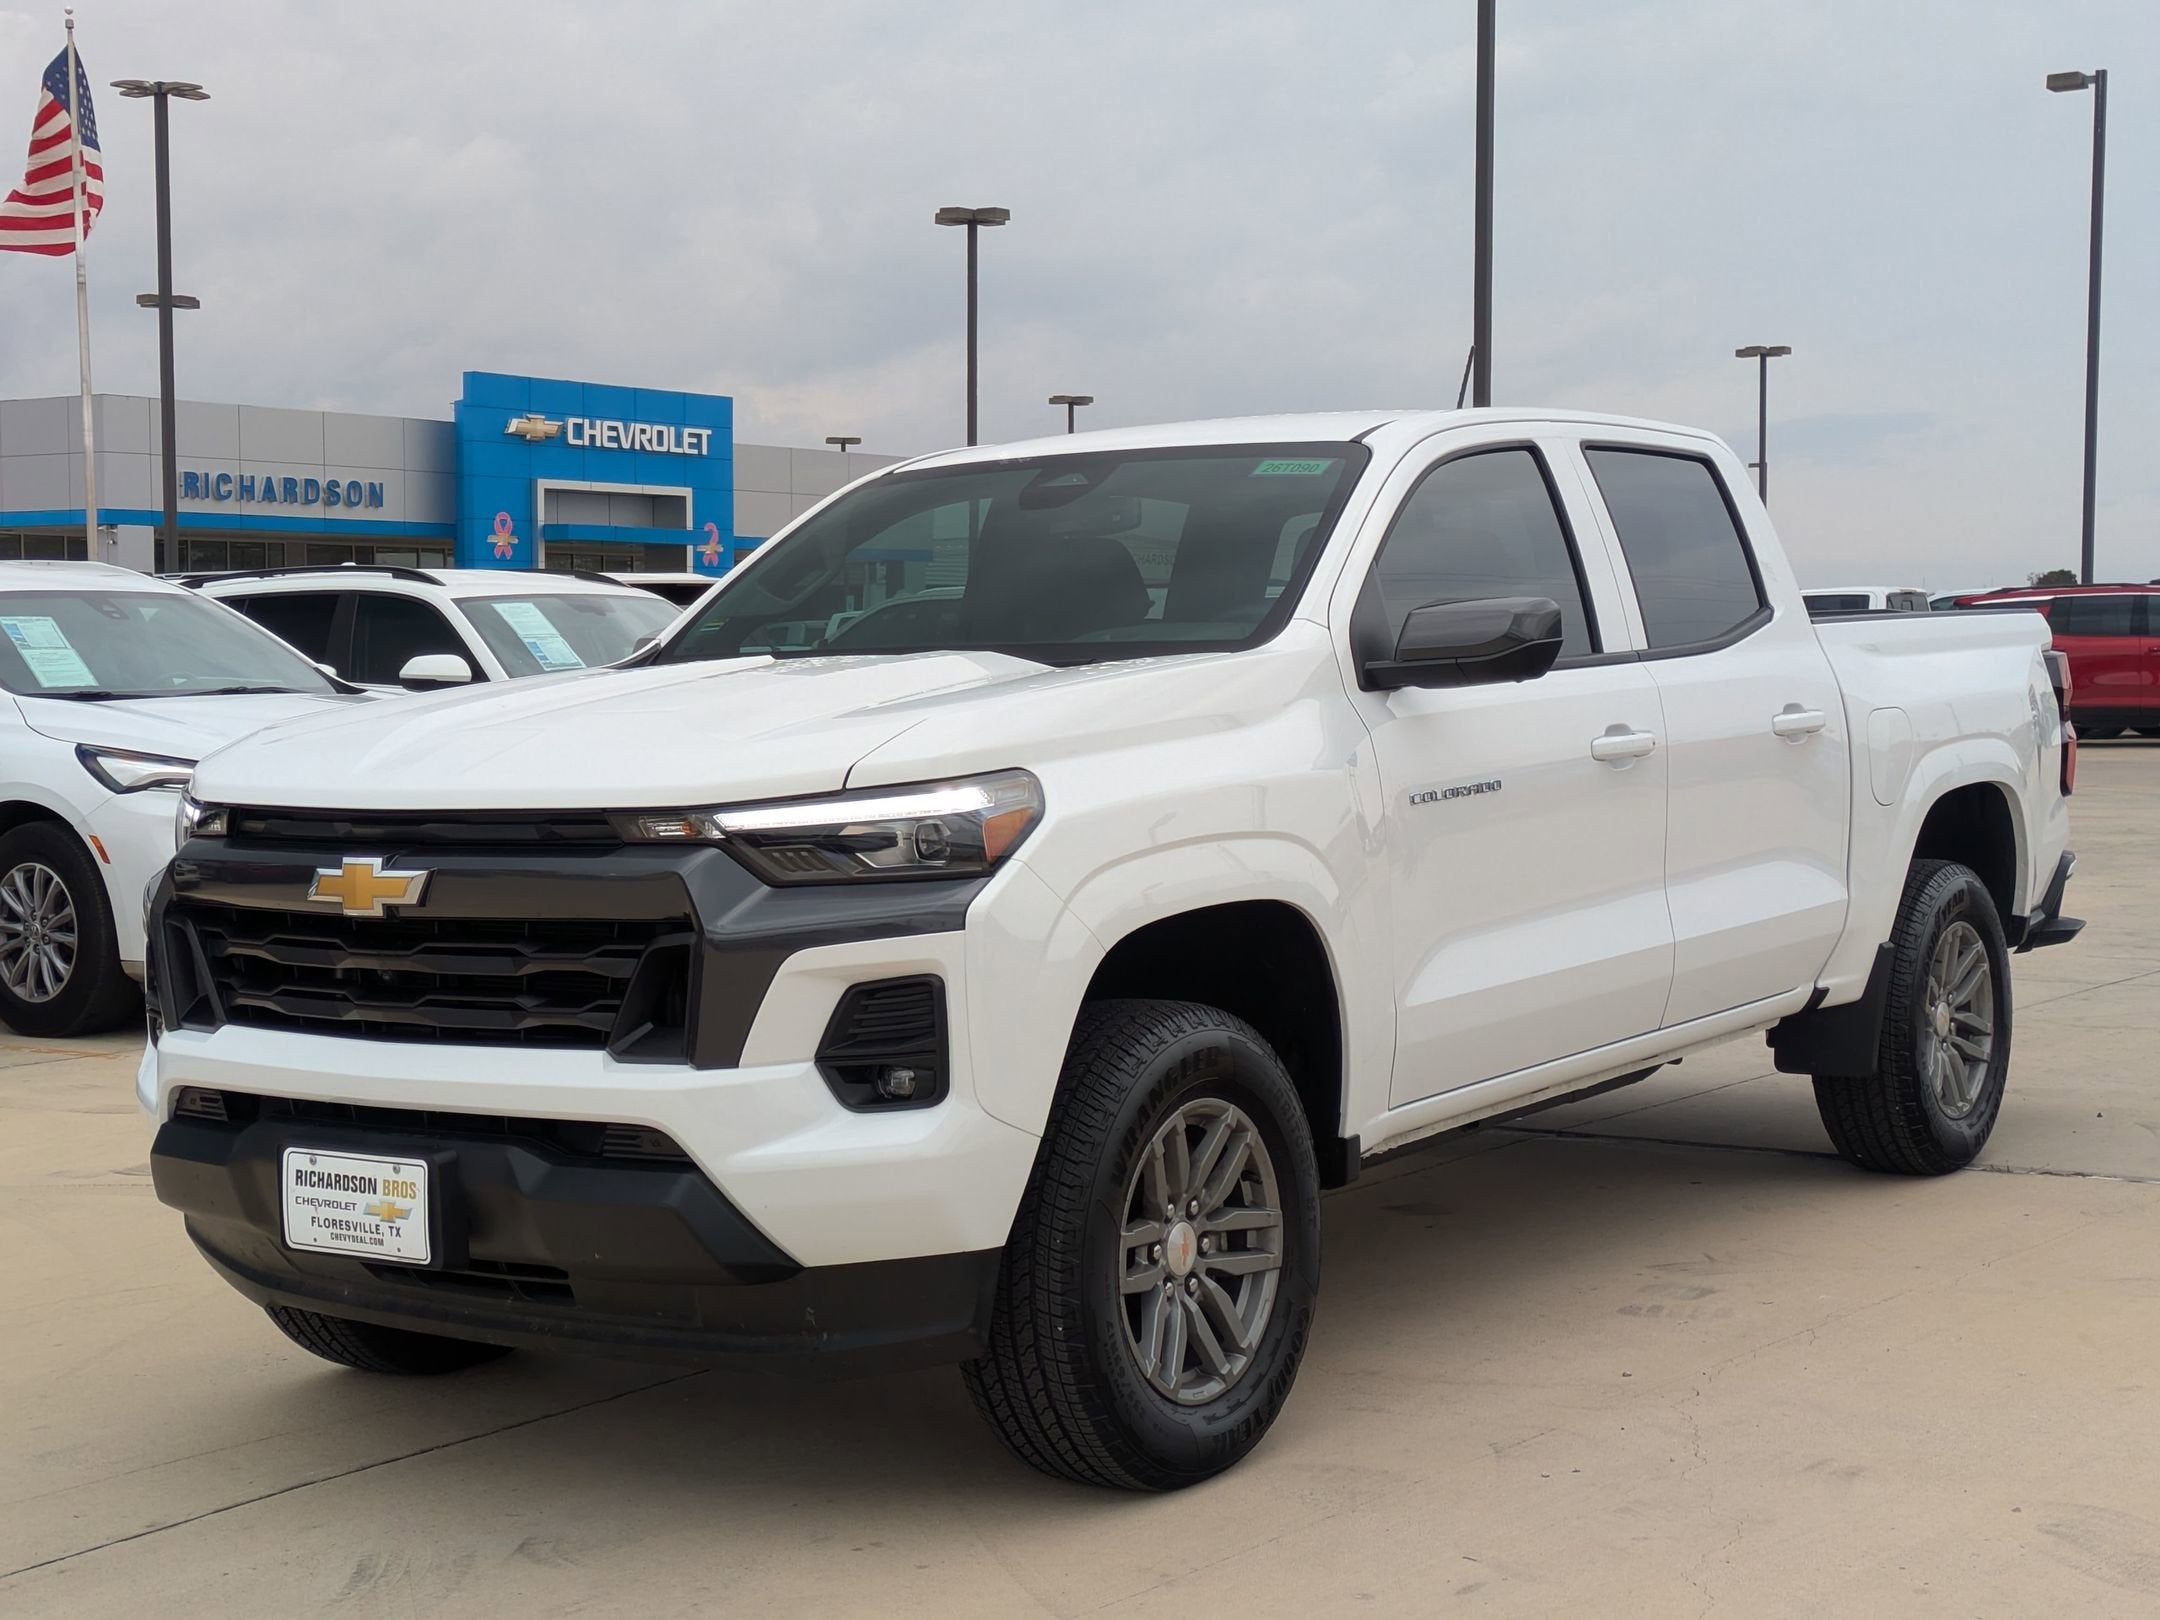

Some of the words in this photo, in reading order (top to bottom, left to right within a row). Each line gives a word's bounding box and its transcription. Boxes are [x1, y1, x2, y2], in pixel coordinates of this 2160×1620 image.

[567, 417, 712, 455] CHEVROLET
[180, 470, 384, 508] RICHARDSON
[1409, 779, 1502, 805] COLORADO
[295, 1169, 377, 1195] RICHARDSON
[382, 1179, 417, 1200] BROS
[295, 1196, 357, 1212] CHEVROLET
[311, 1216, 384, 1237] FLORESVILLE,
[388, 1225, 402, 1238] TX
[330, 1232, 384, 1246] CHEVYDEAL.COM
